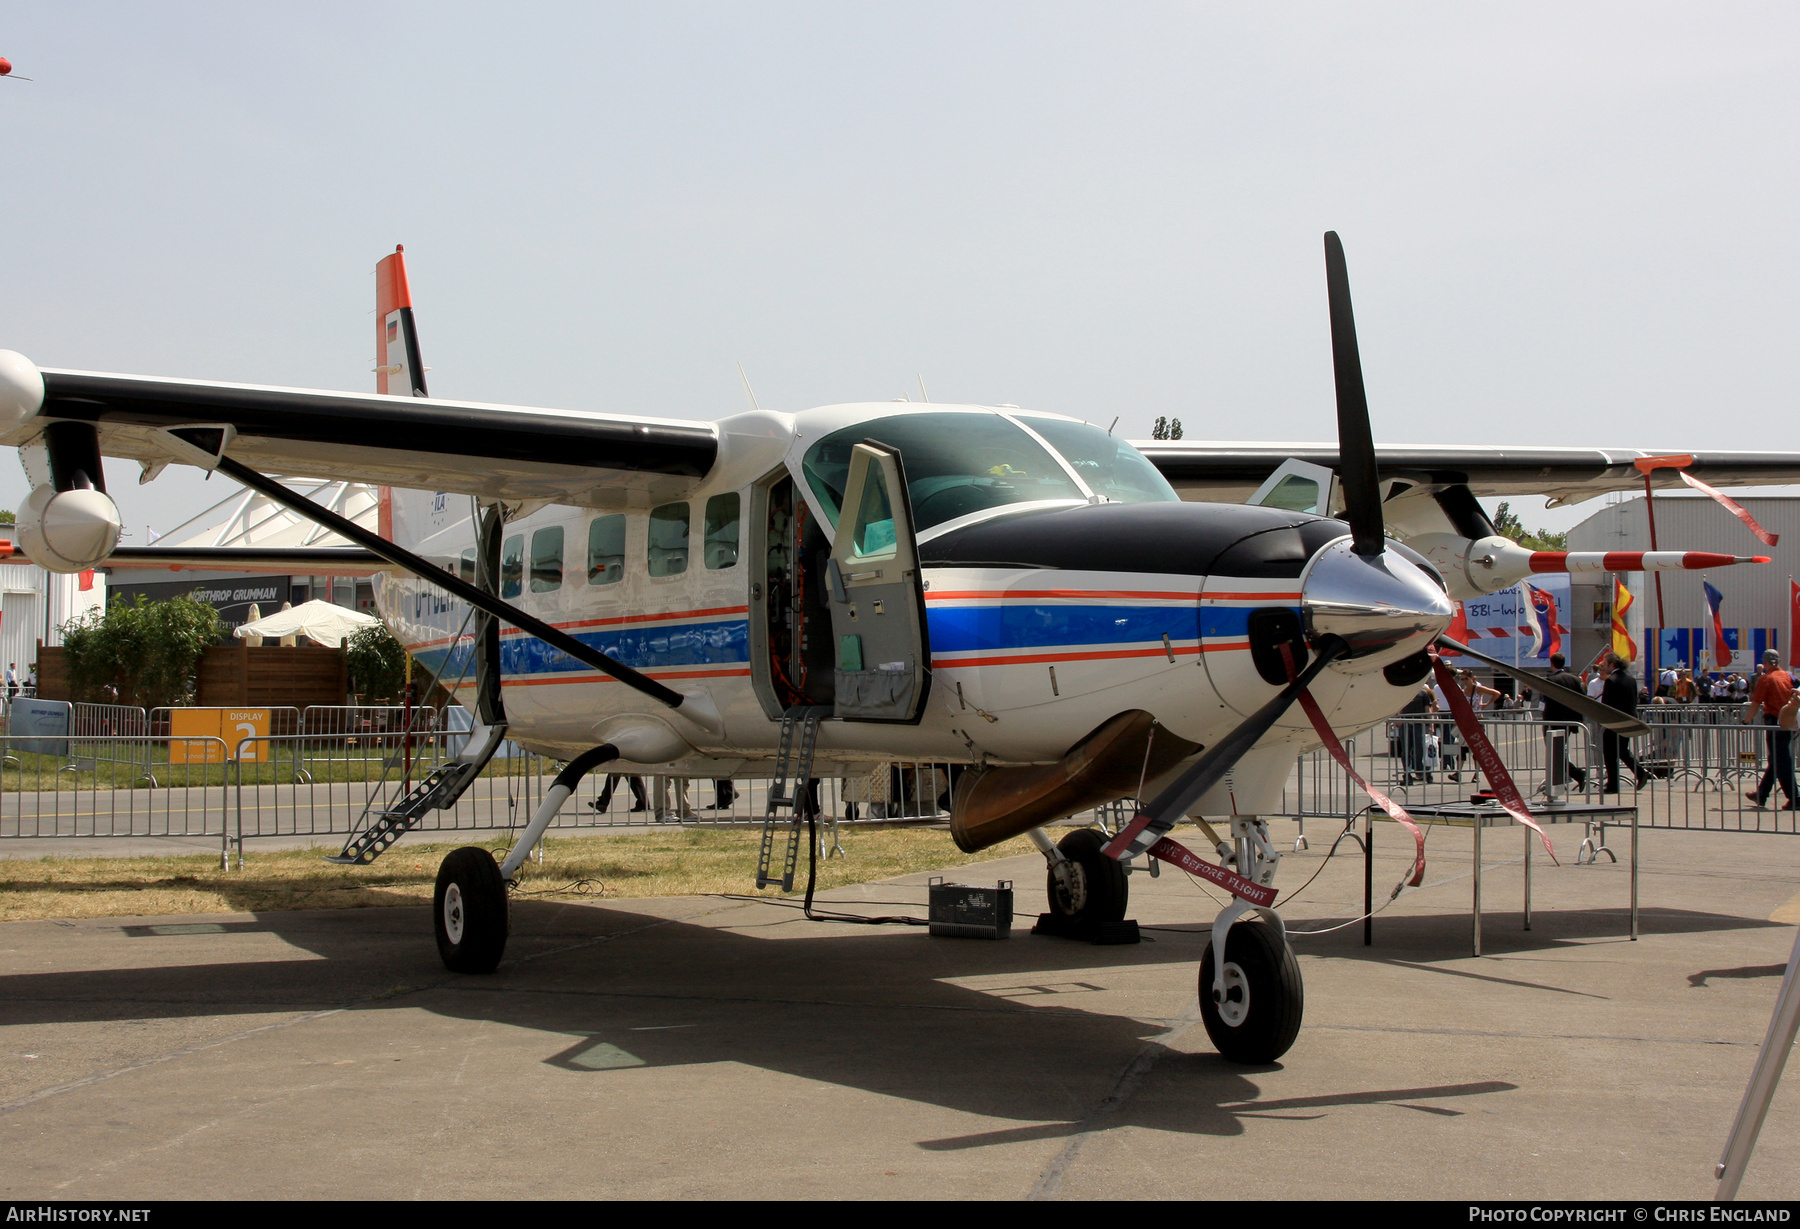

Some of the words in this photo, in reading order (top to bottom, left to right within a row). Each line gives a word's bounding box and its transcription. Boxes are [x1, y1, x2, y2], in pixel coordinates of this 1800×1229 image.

[233, 587, 277, 600] GRUMMAN
[230, 712, 263, 721] DISPLAY
[233, 722, 256, 759] 2
[1181, 854, 1225, 881] BEFORE
[1228, 876, 1268, 901] FLIGHT
